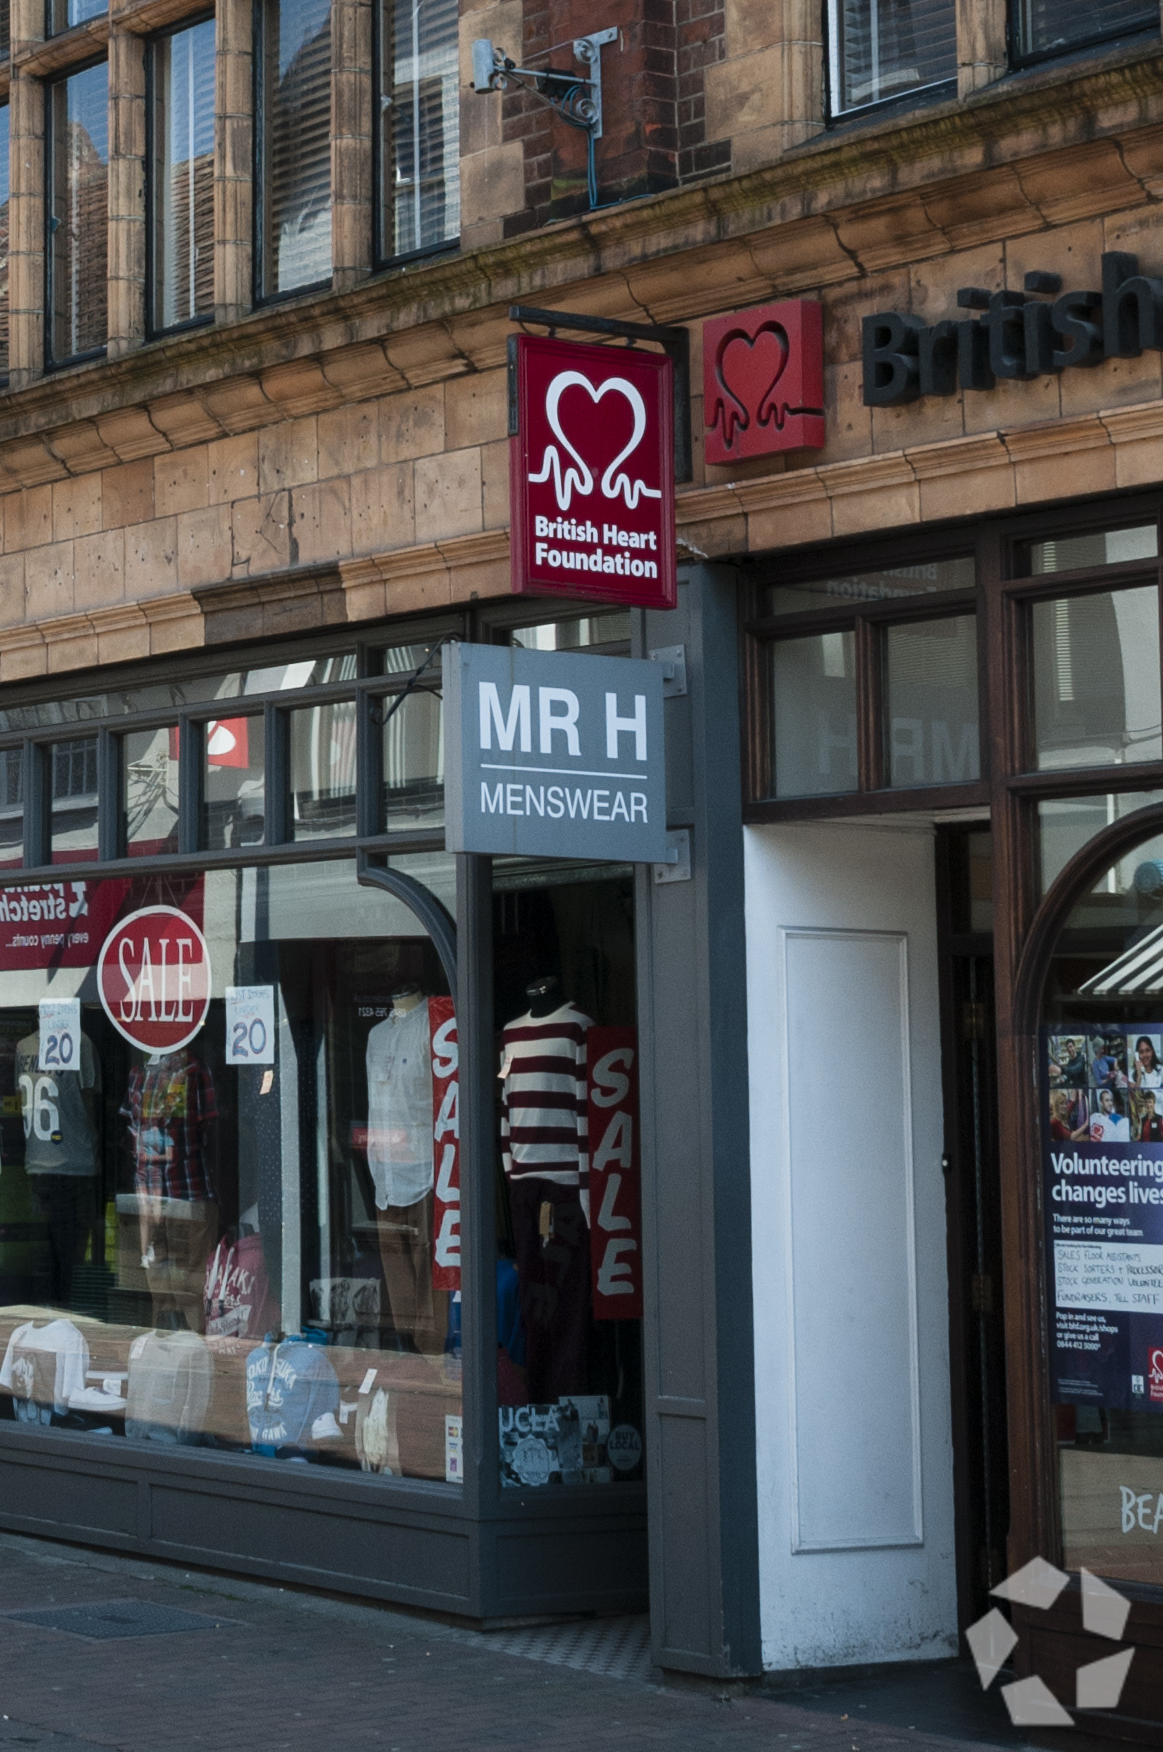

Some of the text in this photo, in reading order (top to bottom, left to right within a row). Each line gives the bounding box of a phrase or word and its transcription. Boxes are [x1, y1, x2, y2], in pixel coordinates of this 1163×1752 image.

[862, 251, 1163, 408] British
[535, 514, 657, 550] British Heart
[535, 542, 658, 579] Foundation
[478, 681, 647, 761] MR H
[480, 782, 648, 823] MENSWEAR
[118, 937, 194, 1023] SALE
[44, 1032, 74, 1066] 20
[232, 1017, 267, 1057] 20
[432, 1017, 462, 1269] SALE
[590, 1048, 637, 1296] SALE
[1050, 1152, 1163, 1183] Volunteering
[1052, 1179, 1126, 1208] changes
[1052, 1213, 1130, 1227] There are so many ways
[1053, 1225, 1061, 1233] to
[1061, 1224, 1070, 1234] be
[1071, 1226, 1085, 1236] part
[1086, 1225, 1094, 1235] of
[1107, 1227, 1125, 1238] great
[1057, 1249, 1081, 1261] SALES
[1084, 1250, 1104, 1261] FLOOR
[1057, 1262, 1079, 1273] STOCK
[1057, 1276, 1078, 1287] STOCK
[1056, 1311, 1067, 1321] Pop
[498, 1405, 561, 1432] UCLA
[609, 1440, 640, 1450] LOCAL
[614, 1431, 635, 1440] BUY
